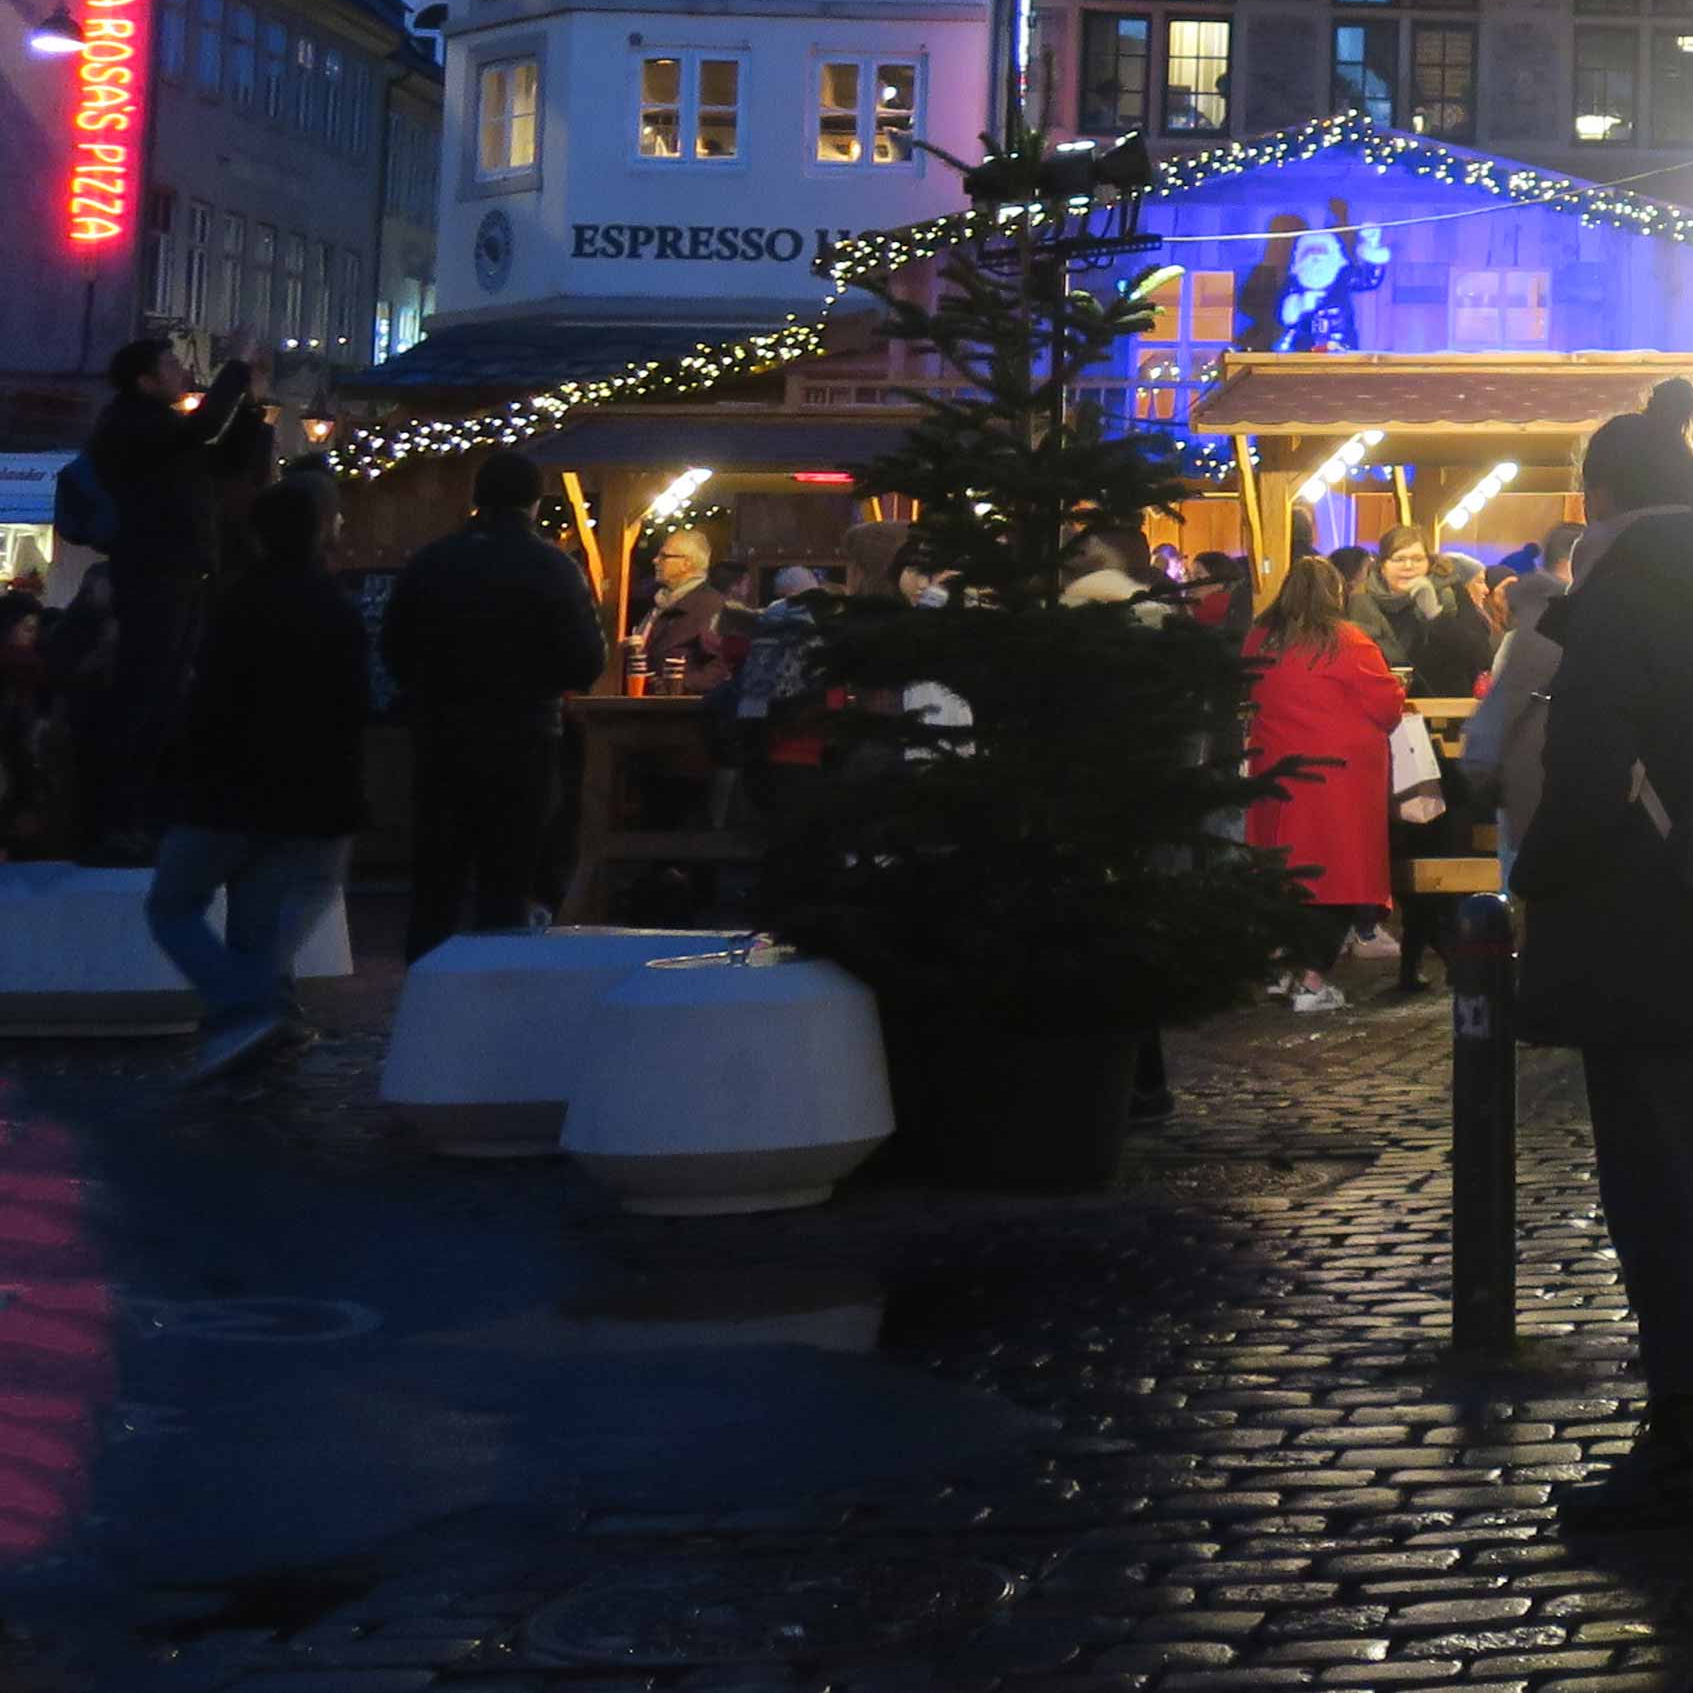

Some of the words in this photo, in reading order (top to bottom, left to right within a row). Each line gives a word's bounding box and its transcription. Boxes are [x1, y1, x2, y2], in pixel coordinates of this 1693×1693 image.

[76, 18, 136, 131] ROSA'S
[69, 142, 127, 241] PIZZA
[571, 224, 803, 261] ESPRESSO
